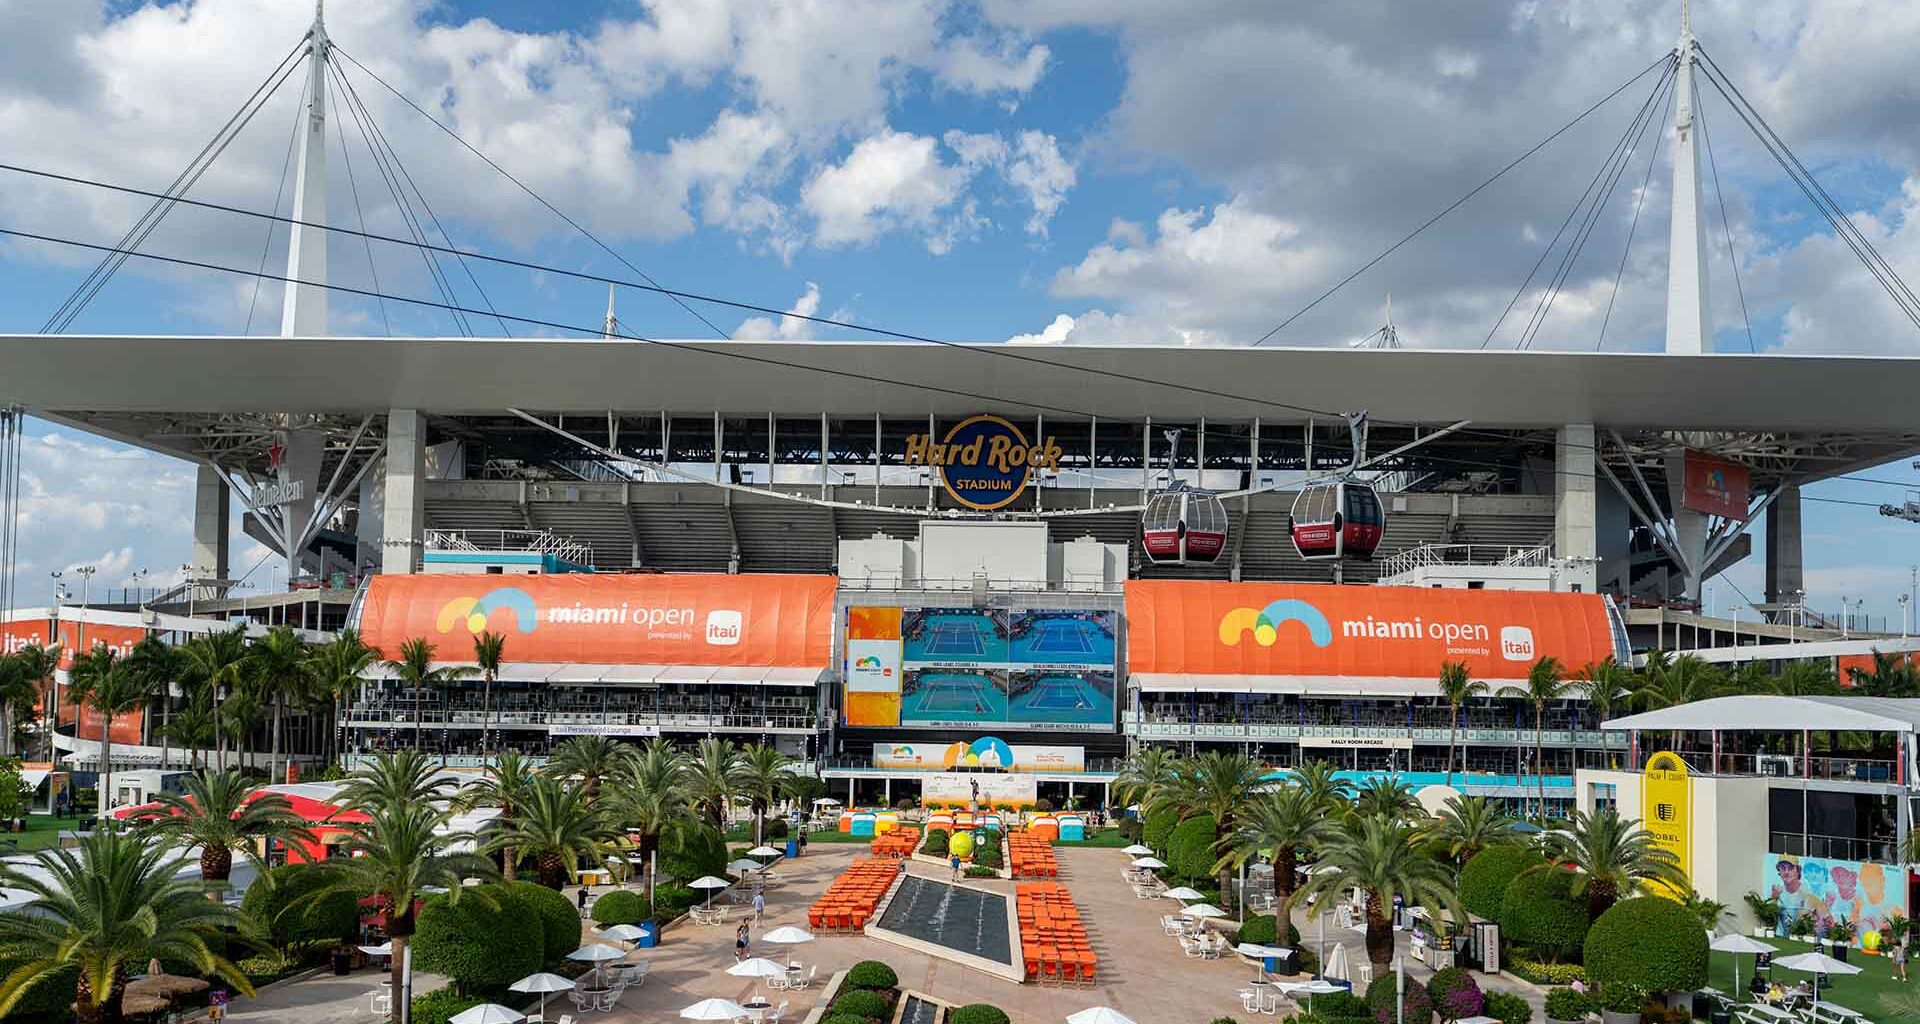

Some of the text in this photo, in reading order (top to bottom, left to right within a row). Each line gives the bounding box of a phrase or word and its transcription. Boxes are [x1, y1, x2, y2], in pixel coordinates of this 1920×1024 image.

[904, 433, 1063, 473] Hard Rock
[956, 478, 1012, 491] STADIUM
[548, 602, 695, 629] miami open
[708, 623, 738, 639] itaú
[1342, 615, 1489, 645] miami open
[1447, 646, 1480, 655] presented
[1503, 640, 1531, 655] itaú
